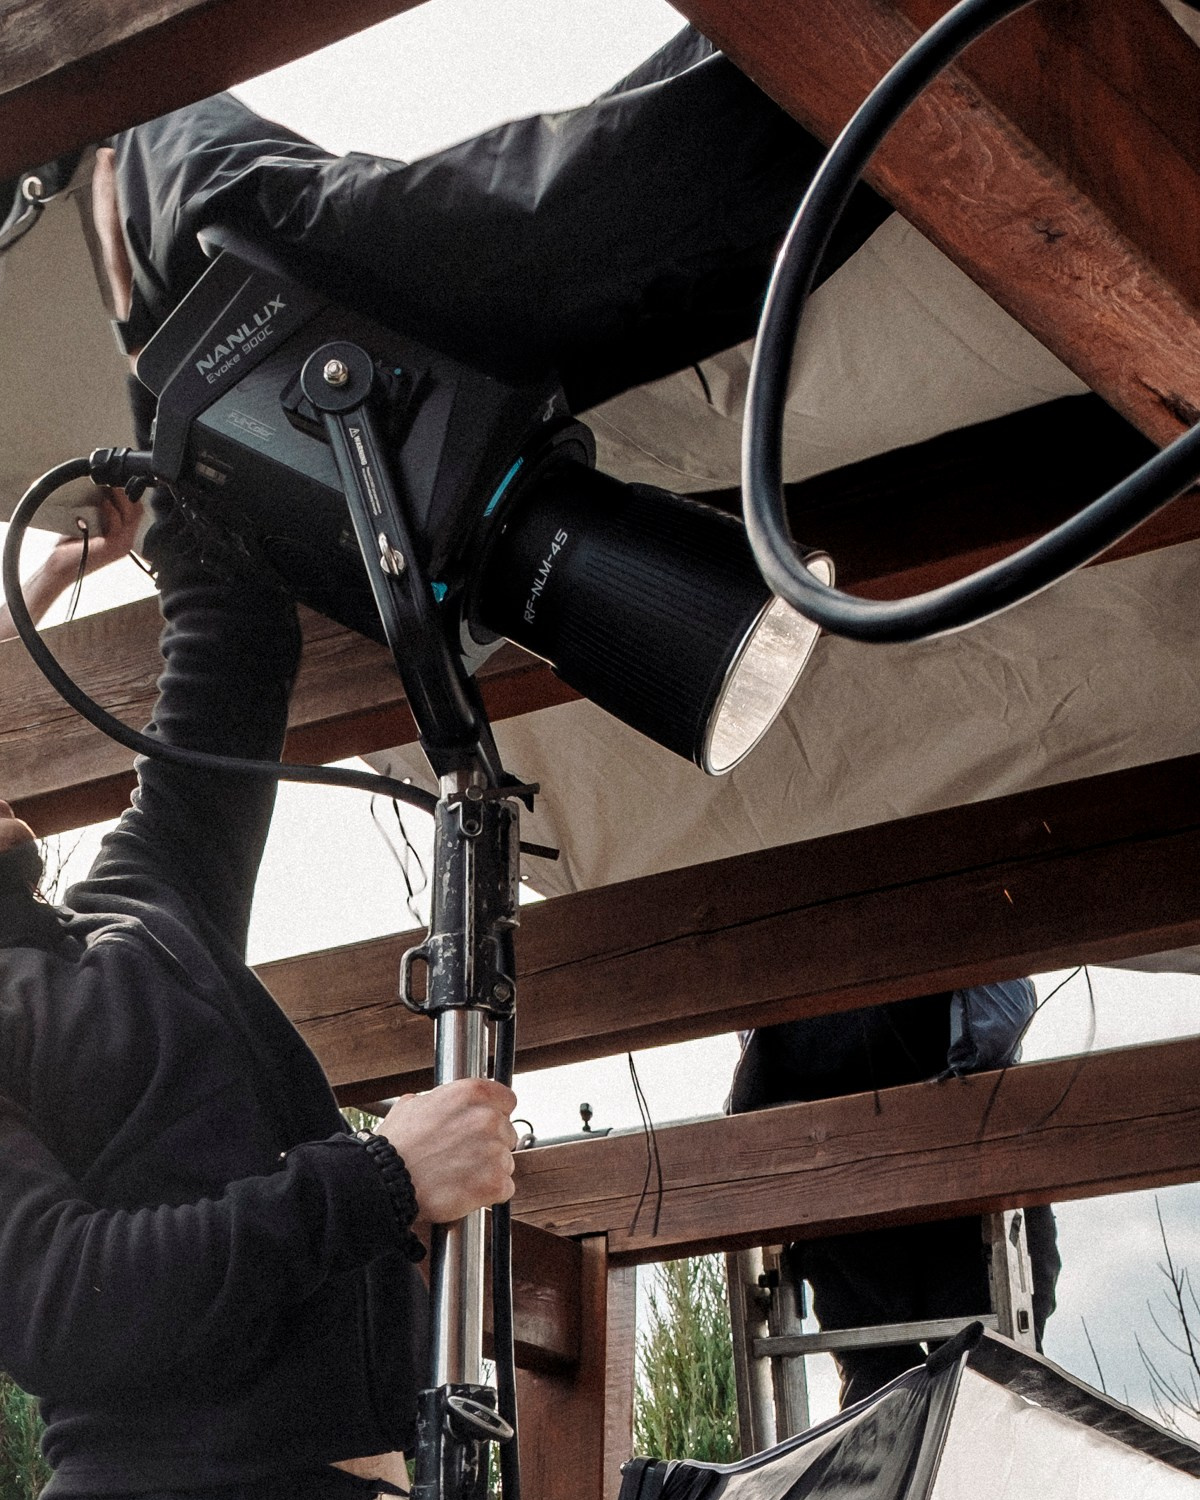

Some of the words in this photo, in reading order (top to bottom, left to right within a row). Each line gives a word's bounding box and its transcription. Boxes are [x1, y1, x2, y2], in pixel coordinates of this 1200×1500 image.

[195, 293, 286, 375] NANLUX
[206, 354, 241, 384] Evoke
[242, 324, 274, 355] 900C
[523, 528, 568, 624] RF-NLM-45
